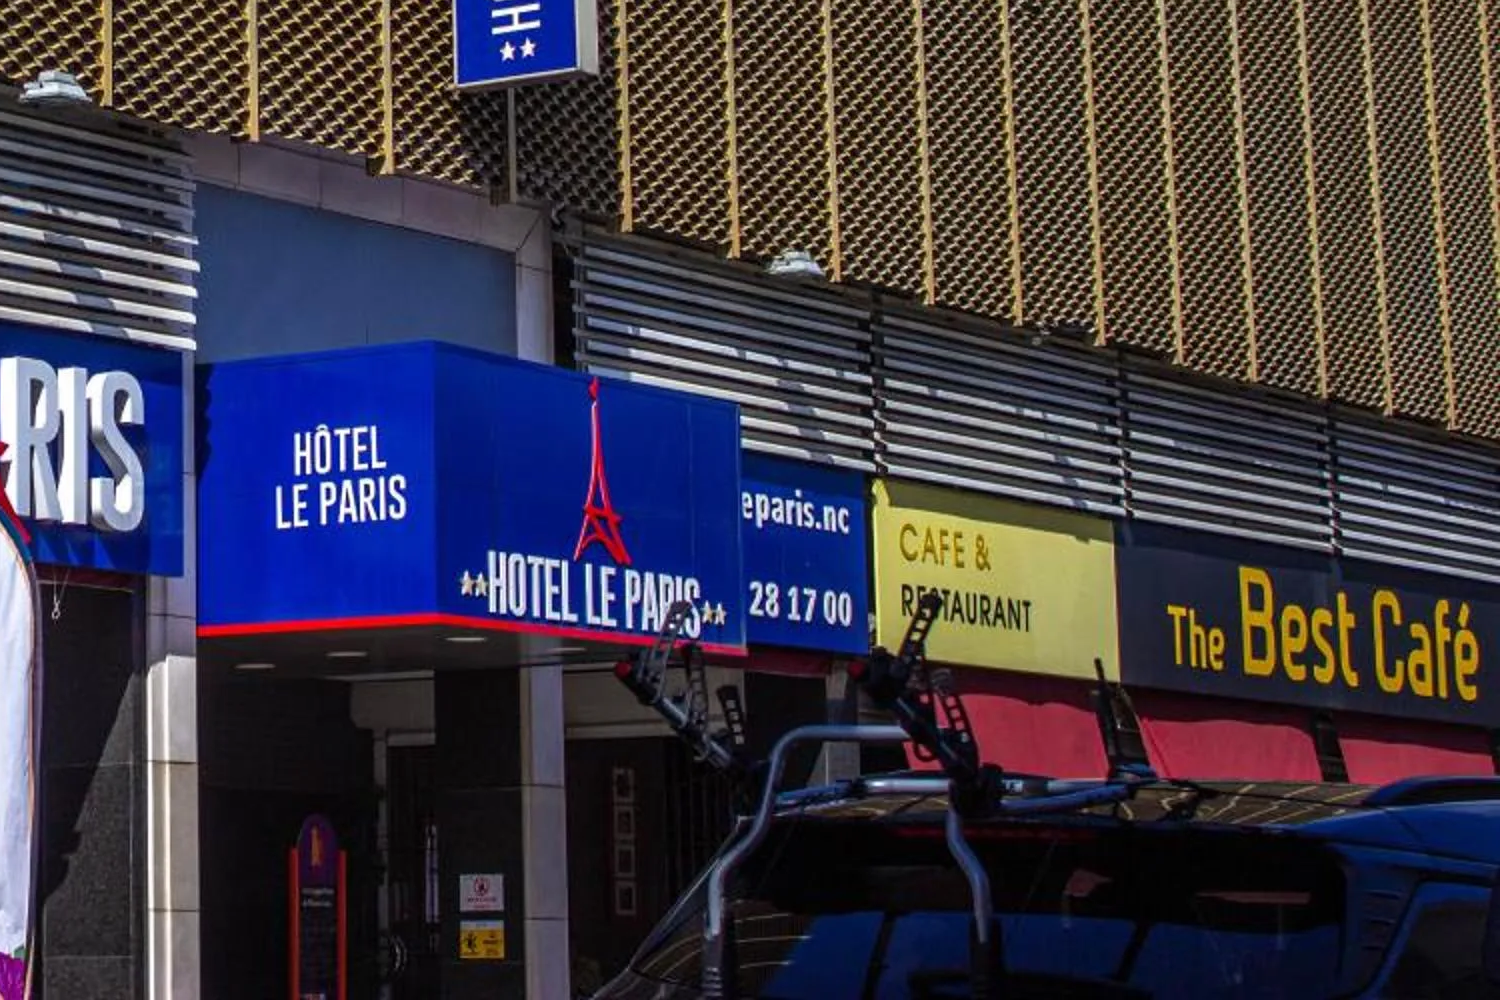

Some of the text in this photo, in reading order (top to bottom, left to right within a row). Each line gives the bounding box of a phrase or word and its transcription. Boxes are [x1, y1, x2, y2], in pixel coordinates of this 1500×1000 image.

[293, 423, 388, 476] HÔTEL
[274, 473, 408, 530] LE PARIS
[899, 522, 992, 572] CAFE &
[486, 549, 578, 624] HOTEL
[584, 562, 618, 628] LE
[749, 580, 853, 628] 28 17 00
[900, 583, 1033, 632] RTAURANT
[1166, 564, 1481, 702] The Best Café
